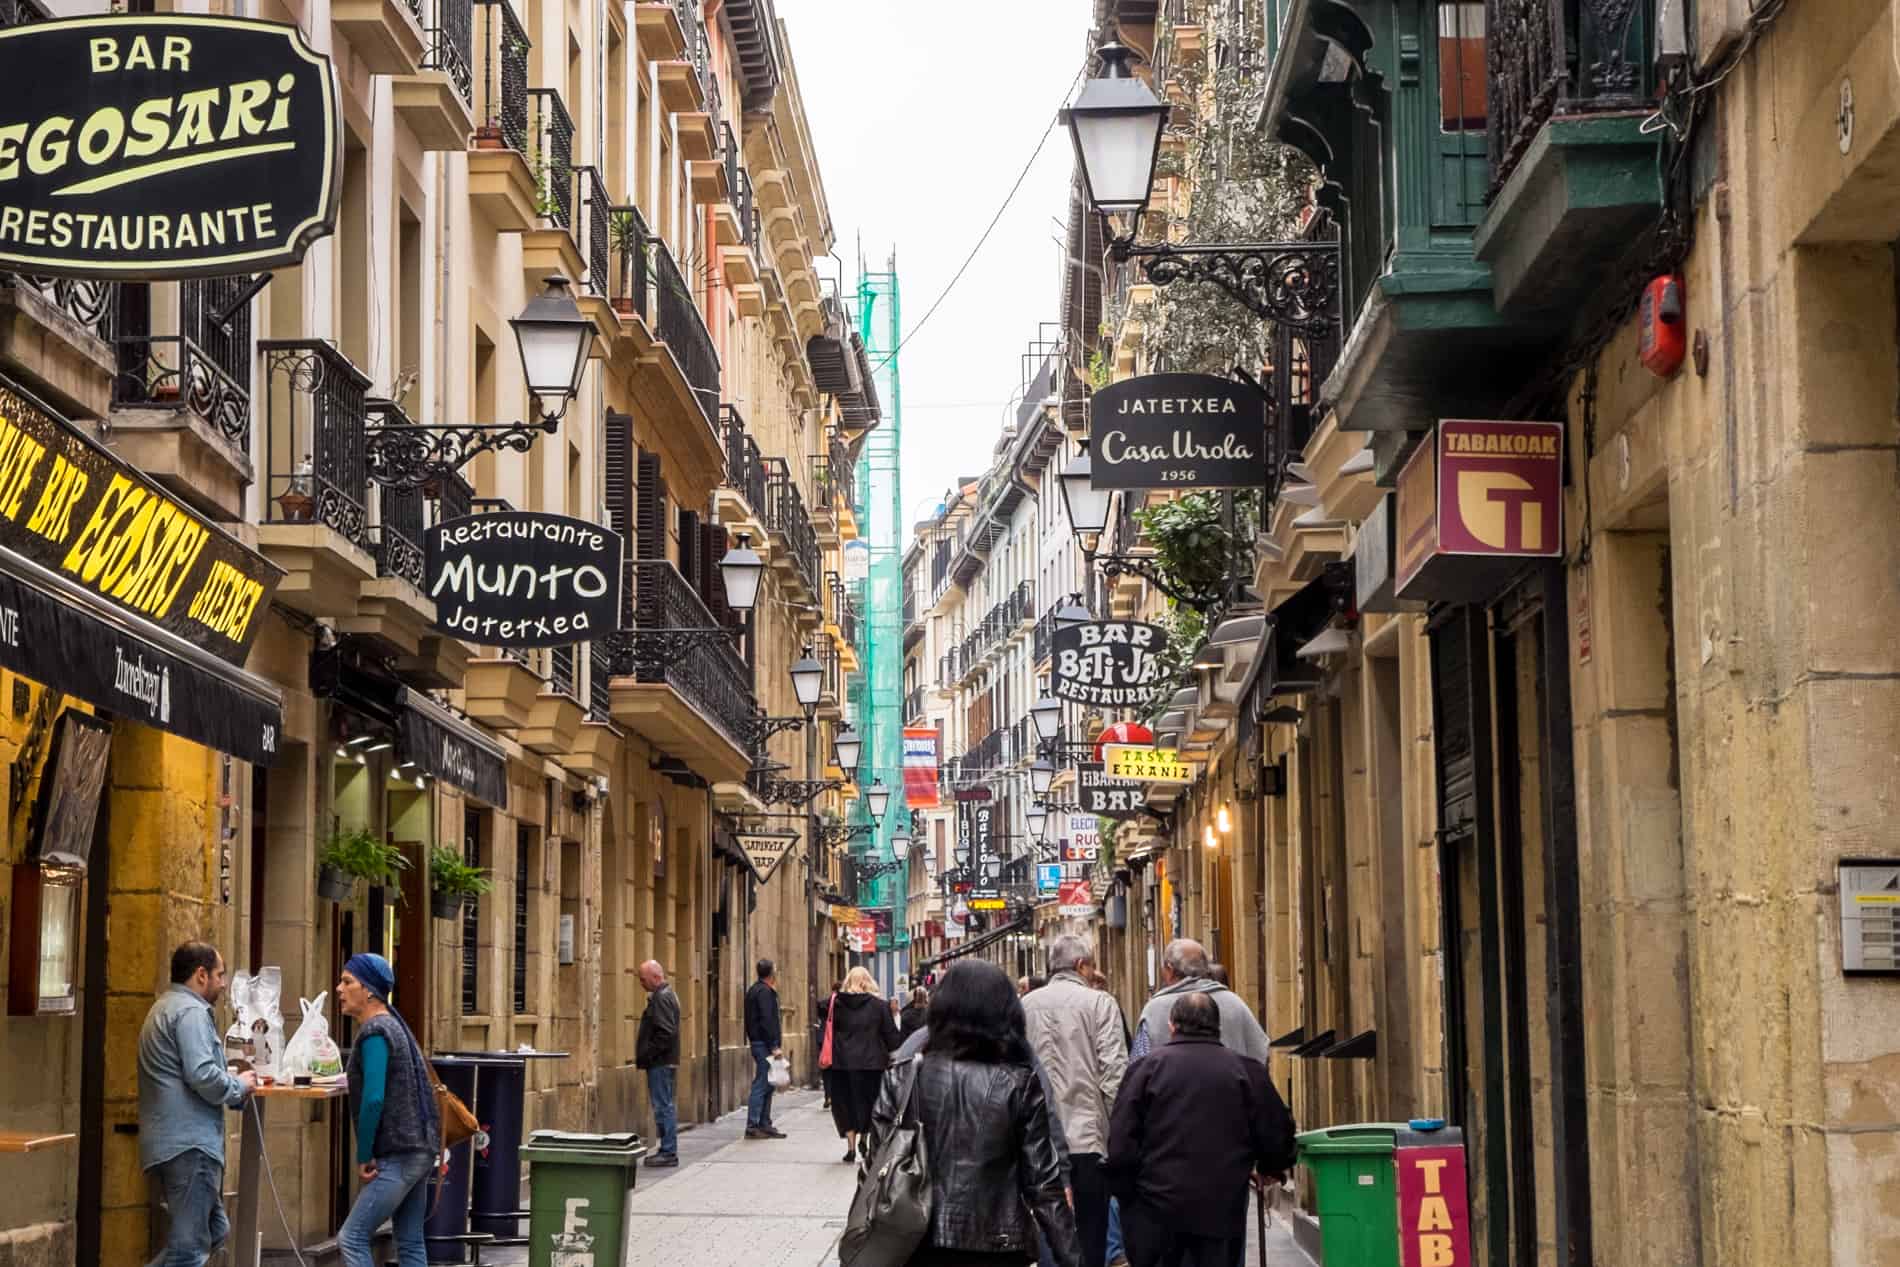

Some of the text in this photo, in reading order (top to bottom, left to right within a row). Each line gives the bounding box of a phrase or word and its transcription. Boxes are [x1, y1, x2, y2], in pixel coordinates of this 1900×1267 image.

[90, 35, 192, 73] BAR
[0, 202, 277, 250] RESTAURANTE
[1117, 398, 1237, 414] JATETXEA
[1102, 429, 1254, 465] Casa Urola
[1445, 433, 1557, 453] TABAKOAK
[1160, 470, 1197, 481] 1956
[26, 453, 89, 544] BAR
[62, 472, 211, 621] EGOSARI
[188, 560, 264, 643] JATETXEA
[440, 520, 604, 552] Restaurante
[431, 553, 608, 602] Munto
[446, 605, 590, 639] Jatetxea
[1079, 623, 1153, 647] BAR
[262, 721, 276, 753] BAR
[1091, 790, 1145, 810] BAR
[1415, 1159, 1455, 1267] TAB
